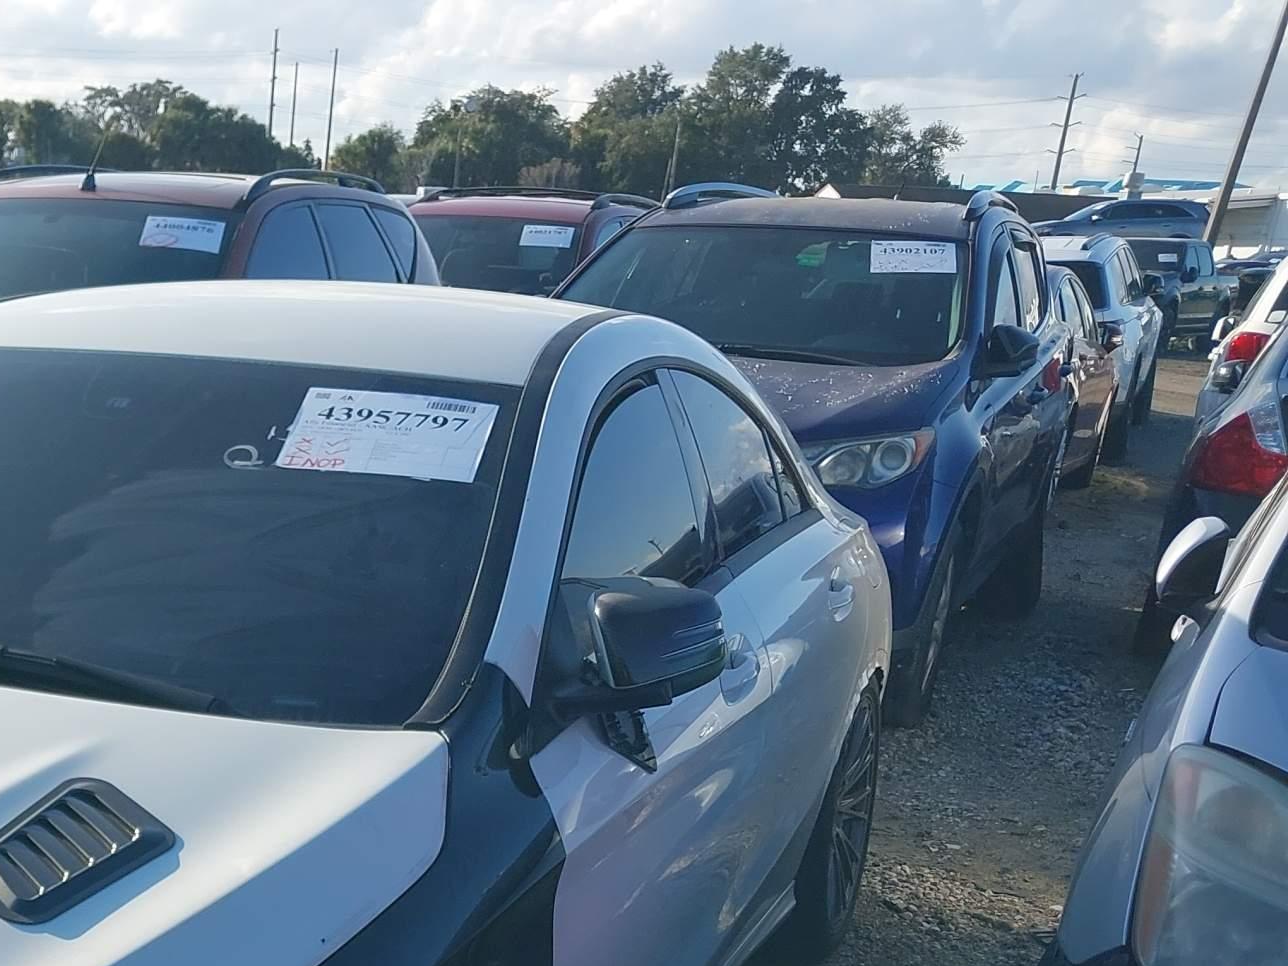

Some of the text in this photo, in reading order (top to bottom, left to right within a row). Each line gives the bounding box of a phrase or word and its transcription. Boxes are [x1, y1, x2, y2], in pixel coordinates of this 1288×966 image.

[879, 247, 945, 255] 43902107
[317, 405, 470, 432] 43957797
[284, 455, 345, 469] INOP
